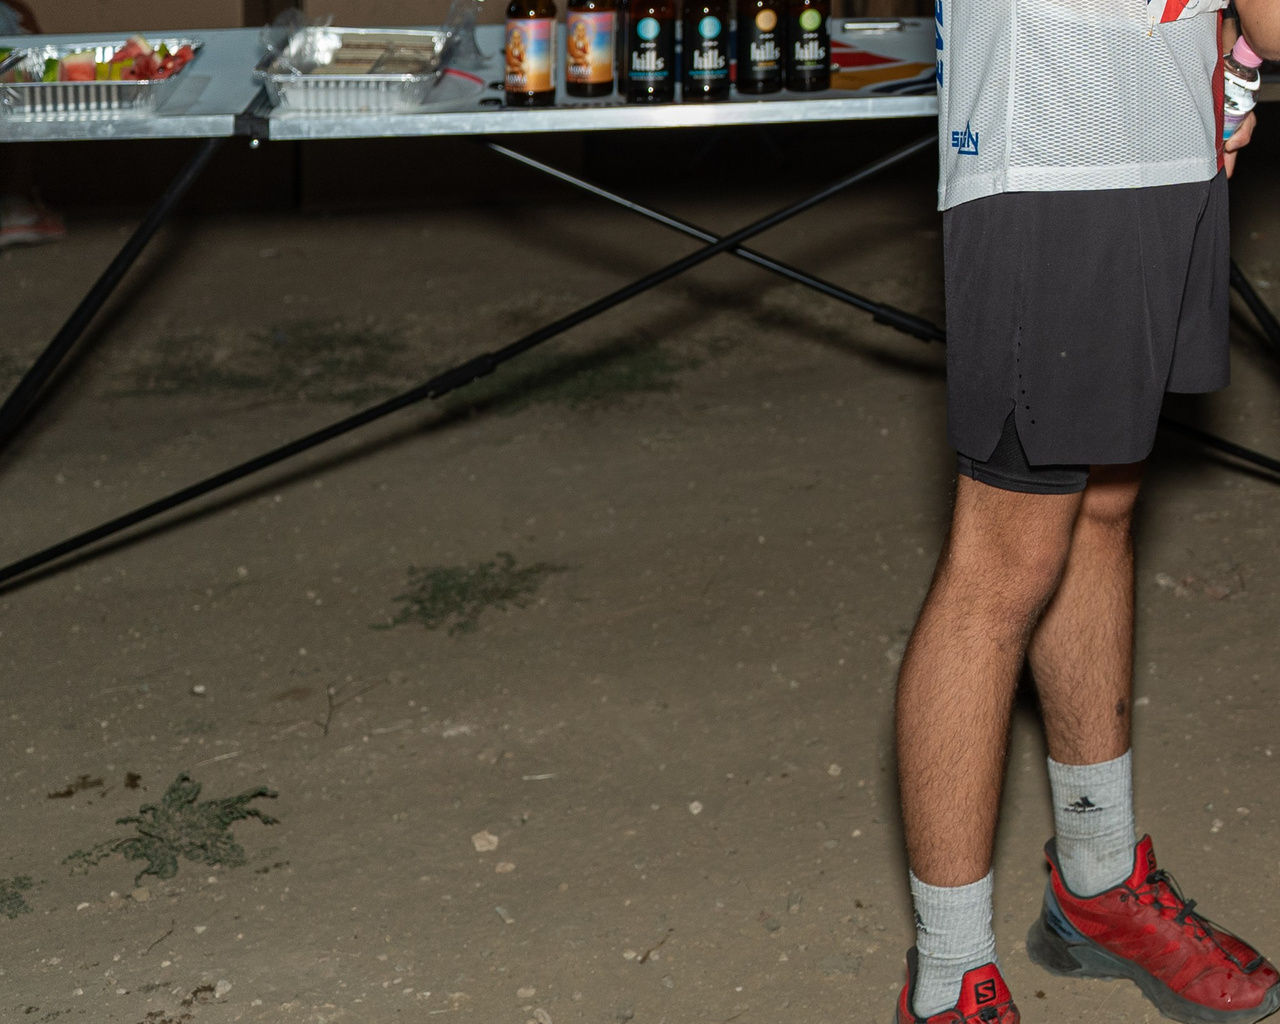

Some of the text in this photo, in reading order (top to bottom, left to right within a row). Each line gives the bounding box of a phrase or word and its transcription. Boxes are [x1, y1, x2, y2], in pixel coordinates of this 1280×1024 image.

[632, 50, 665, 72] hills
[693, 49, 726, 70] hills
[750, 40, 781, 62] hills
[794, 40, 826, 61] hills
